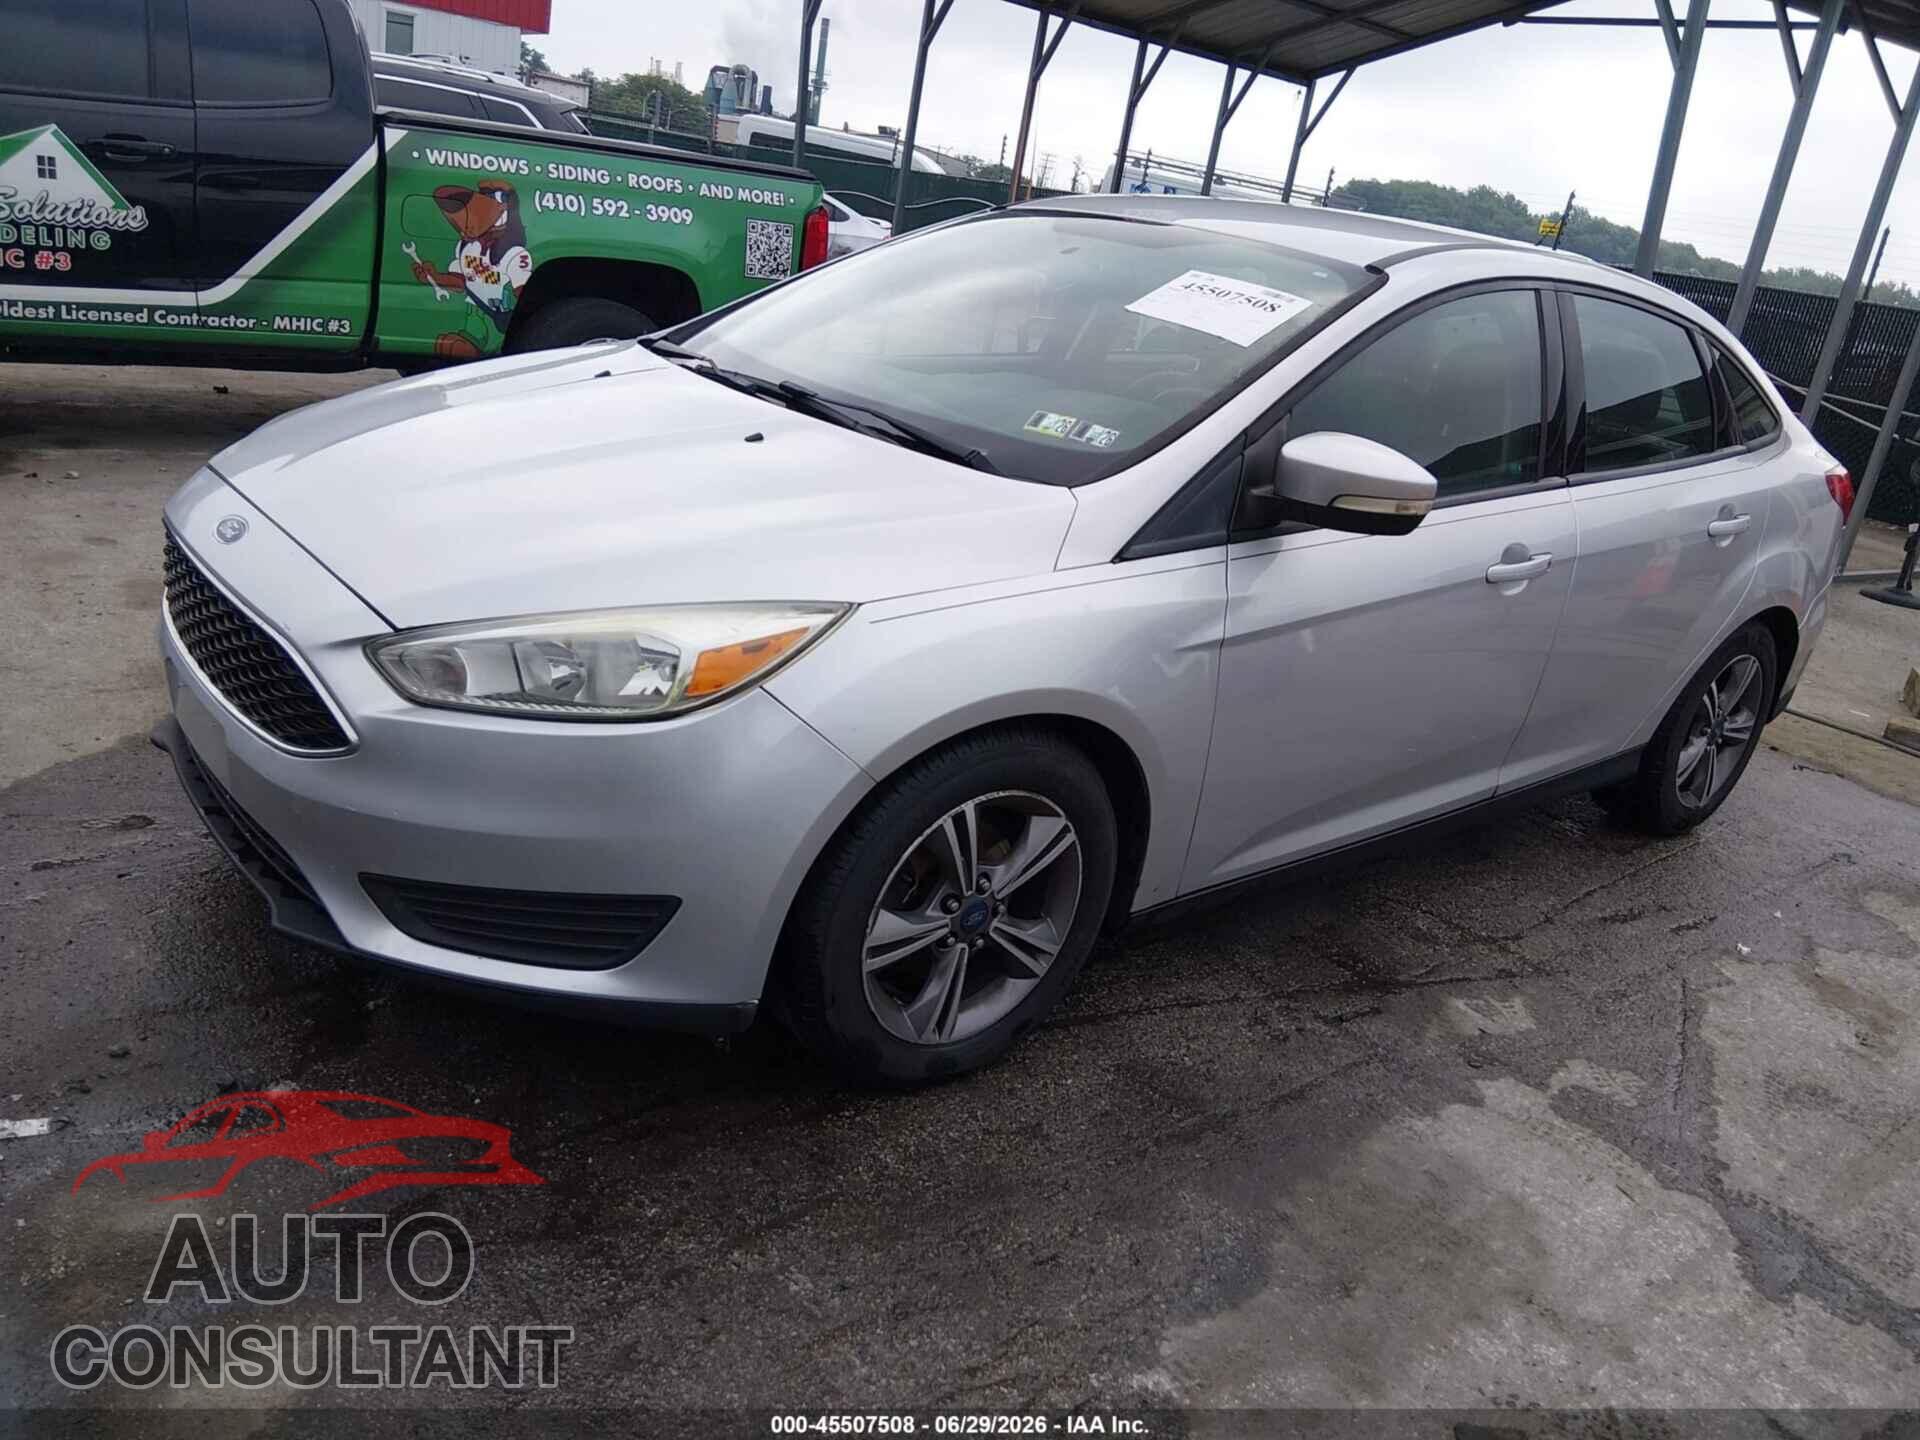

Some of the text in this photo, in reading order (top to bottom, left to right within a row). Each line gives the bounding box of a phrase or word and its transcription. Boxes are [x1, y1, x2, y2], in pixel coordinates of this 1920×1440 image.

[425, 148, 785, 207] WINDOWS SIDING ROOFS AND MORE!
[534, 190, 585, 216] (410)
[592, 198, 630, 218] 592
[646, 204, 694, 225] 3909
[35, 251, 72, 271] #3
[0, 300, 56, 319] ldest
[61, 304, 149, 323] Licensed
[154, 310, 257, 329] Contractor
[273, 315, 324, 332] MHIC
[327, 319, 351, 333] #3
